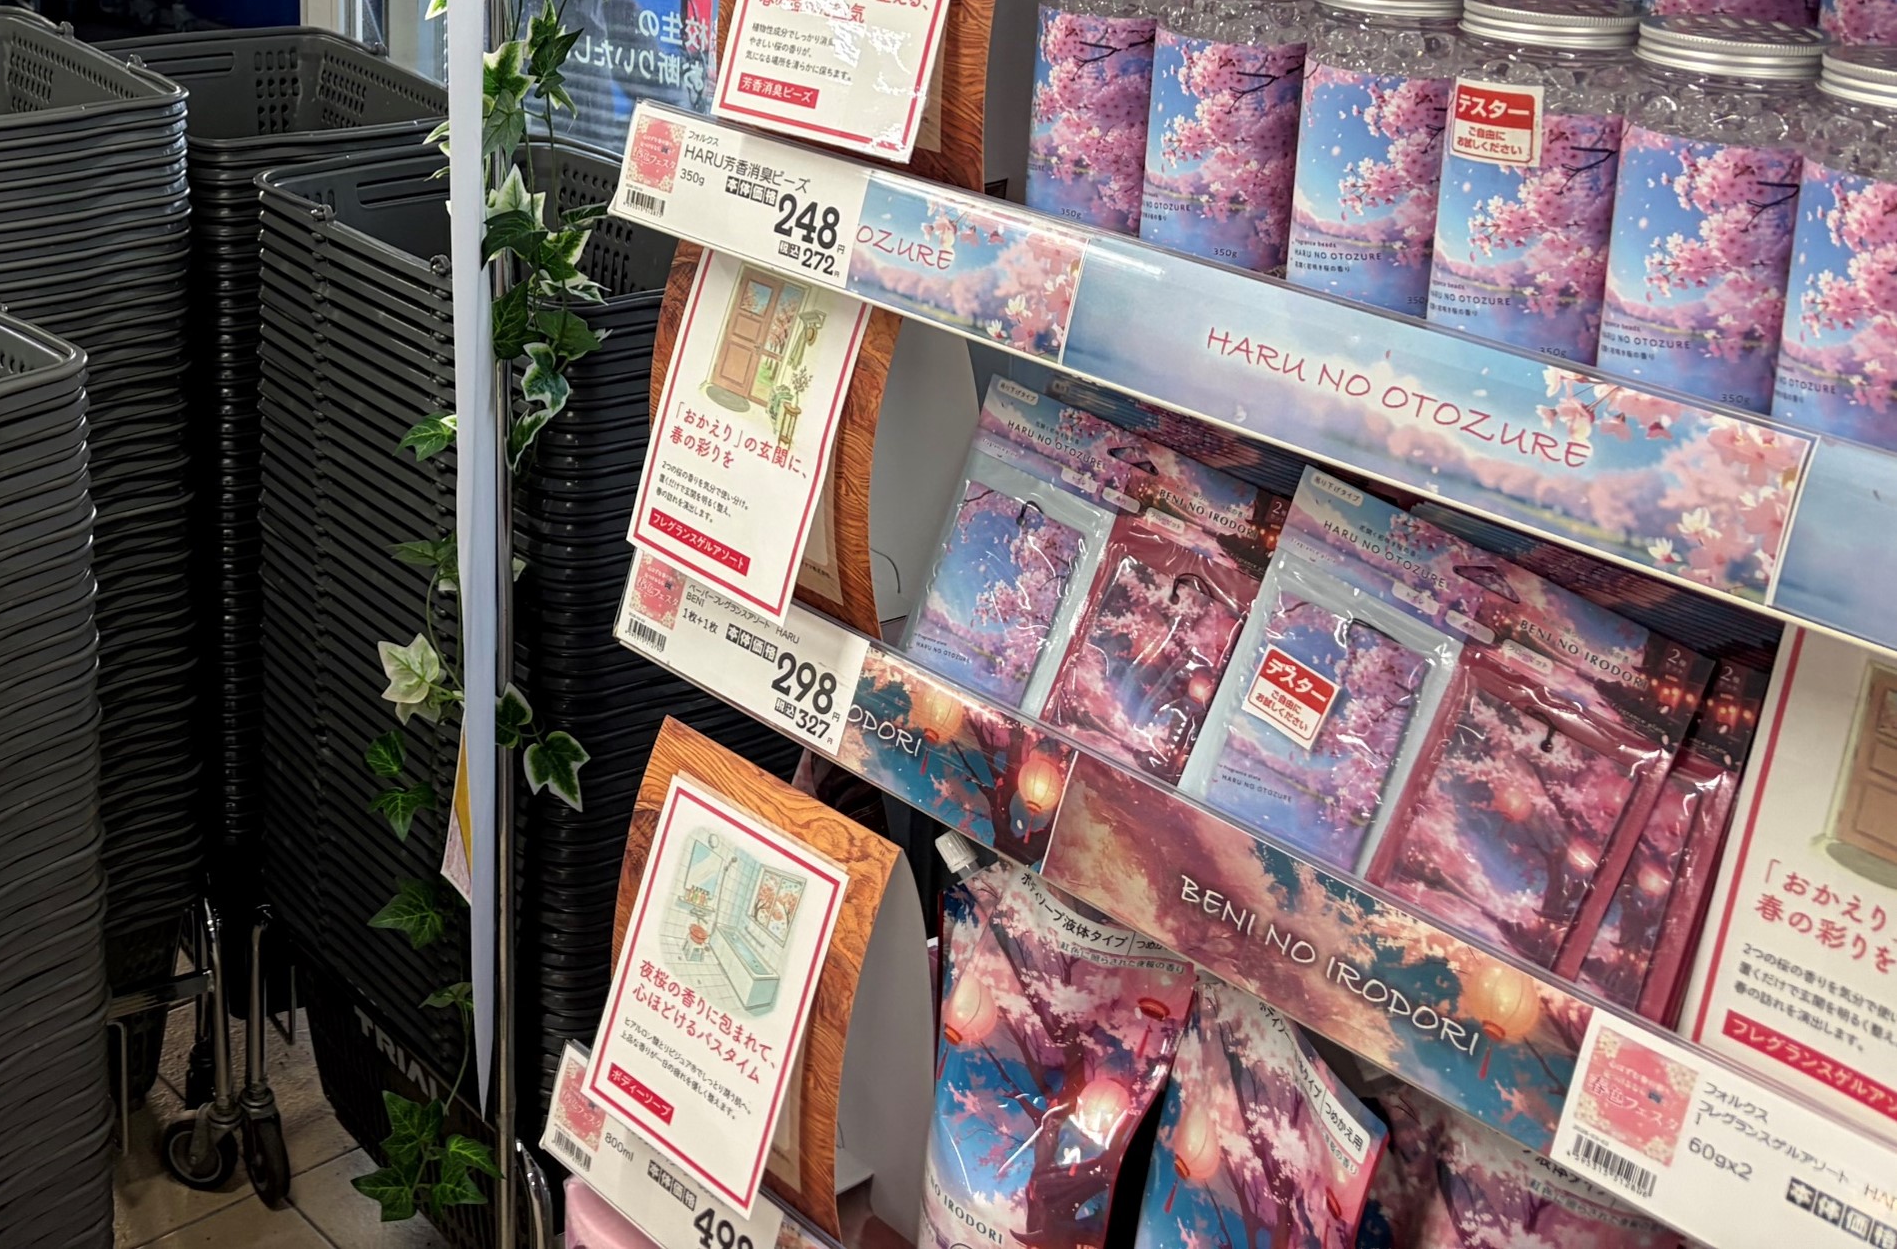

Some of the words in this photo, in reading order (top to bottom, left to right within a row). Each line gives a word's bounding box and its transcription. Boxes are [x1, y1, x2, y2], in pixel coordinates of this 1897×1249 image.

[741, 75, 814, 103] 芳香消臭ビーズ
[1458, 94, 1530, 120] テスター
[688, 130, 720, 148] フォルクス
[1457, 137, 1522, 155] お試しください
[1468, 126, 1506, 141] ご自由に
[680, 168, 705, 187] 350g
[684, 144, 811, 194] HARU芳香消臭ビーズ
[725, 176, 779, 208] 本体価格
[774, 193, 841, 250] 248
[1061, 208, 1082, 219] 350g
[778, 240, 801, 260] 税込
[801, 248, 835, 276] 272
[856, 224, 954, 271] OZURE
[1213, 247, 1238, 259] 350g
[1330, 251, 1383, 262] OTOZURE
[1458, 294, 1511, 306] OTOZURE
[1634, 337, 1691, 350] OTOZURE
[1206, 325, 1309, 382] HARU
[1318, 362, 1369, 398] NO
[1383, 384, 1591, 469] OTOZURE
[669, 425, 735, 469] 春の彩りを
[674, 401, 808, 480] 「おかえり」の玄関に、
[1008, 420, 1035, 438] HARU
[1037, 434, 1052, 446] NO
[1055, 442, 1102, 469] OTOZURE
[662, 460, 749, 511] 2つの桜の香りを気分で使い分け。
[1314, 476, 1360, 501] 吊り下げタイプ
[1159, 489, 1184, 506] BENI
[1187, 503, 1205, 515] NO
[1208, 511, 1258, 540] IRODORI
[652, 512, 746, 570] フレグランスゲルアソート
[1323, 520, 1358, 543] HARU
[1362, 540, 1380, 554] NO
[1385, 551, 1446, 588] OTOZURE
[682, 608, 718, 634] 1枚+1枚
[775, 627, 800, 644] HARU
[725, 623, 778, 663] 本体価格
[771, 652, 837, 715] 298
[1520, 619, 1552, 641] BENI
[1558, 638, 1580, 655] NO
[1584, 652, 1648, 692] IRODORI
[1266, 658, 1328, 702] テスター
[1271, 689, 1302, 714] ご自由に
[775, 697, 797, 719] 税込
[796, 709, 831, 740] 327
[1256, 692, 1309, 732] お試しください
[1222, 774, 1242, 786] HARU
[1257, 785, 1292, 803] OTOZURE
[1020, 871, 1128, 949] ボディソープ液体タイプ
[1754, 893, 1896, 974] 春の彩りを
[1180, 875, 1255, 938] BENI
[1264, 921, 1318, 965] NO
[1325, 959, 1482, 1056] IRODORI
[631, 985, 761, 1085] 心ほどけるバスタイム
[638, 958, 777, 1070] 夜桜の香りに包まれて、
[611, 1068, 672, 1118] ボディーソープ
[1704, 1082, 1769, 1123] フォルクス
[604, 1132, 635, 1163] 800ml
[1325, 1101, 1365, 1152] つめかえ用
[1699, 1099, 1850, 1184] フレグランスゲルアソート
[1688, 1137, 1753, 1182] 60gx2
[647, 1159, 698, 1212] 本体価格
[943, 1196, 1003, 1245] IRODORI
